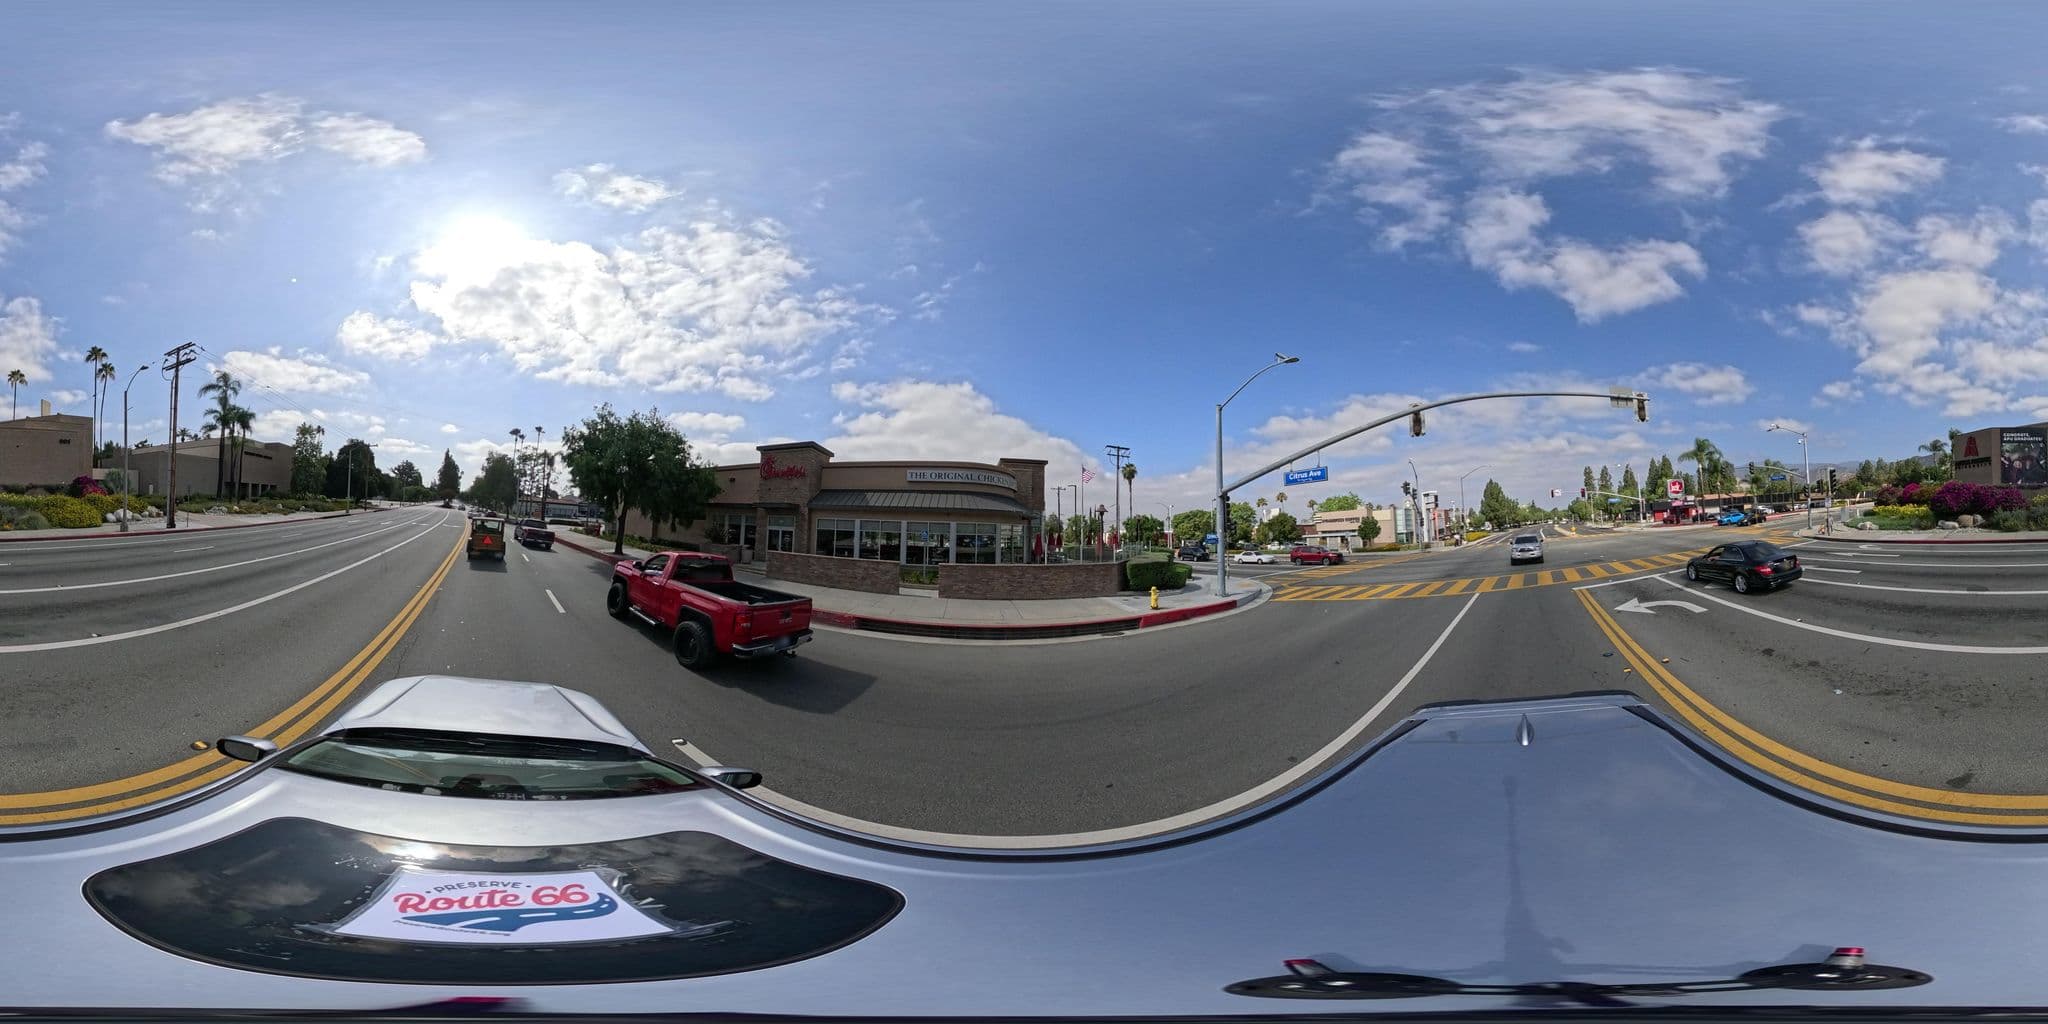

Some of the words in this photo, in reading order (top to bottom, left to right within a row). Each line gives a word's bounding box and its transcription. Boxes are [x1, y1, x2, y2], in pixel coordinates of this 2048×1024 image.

[909, 471, 928, 480] THE
[929, 471, 974, 481] ORIGINAL
[1289, 471, 1308, 480] Citrus
[434, 881, 522, 893] PRESERVE
[393, 889, 525, 913] Route
[532, 883, 590, 906] 66
